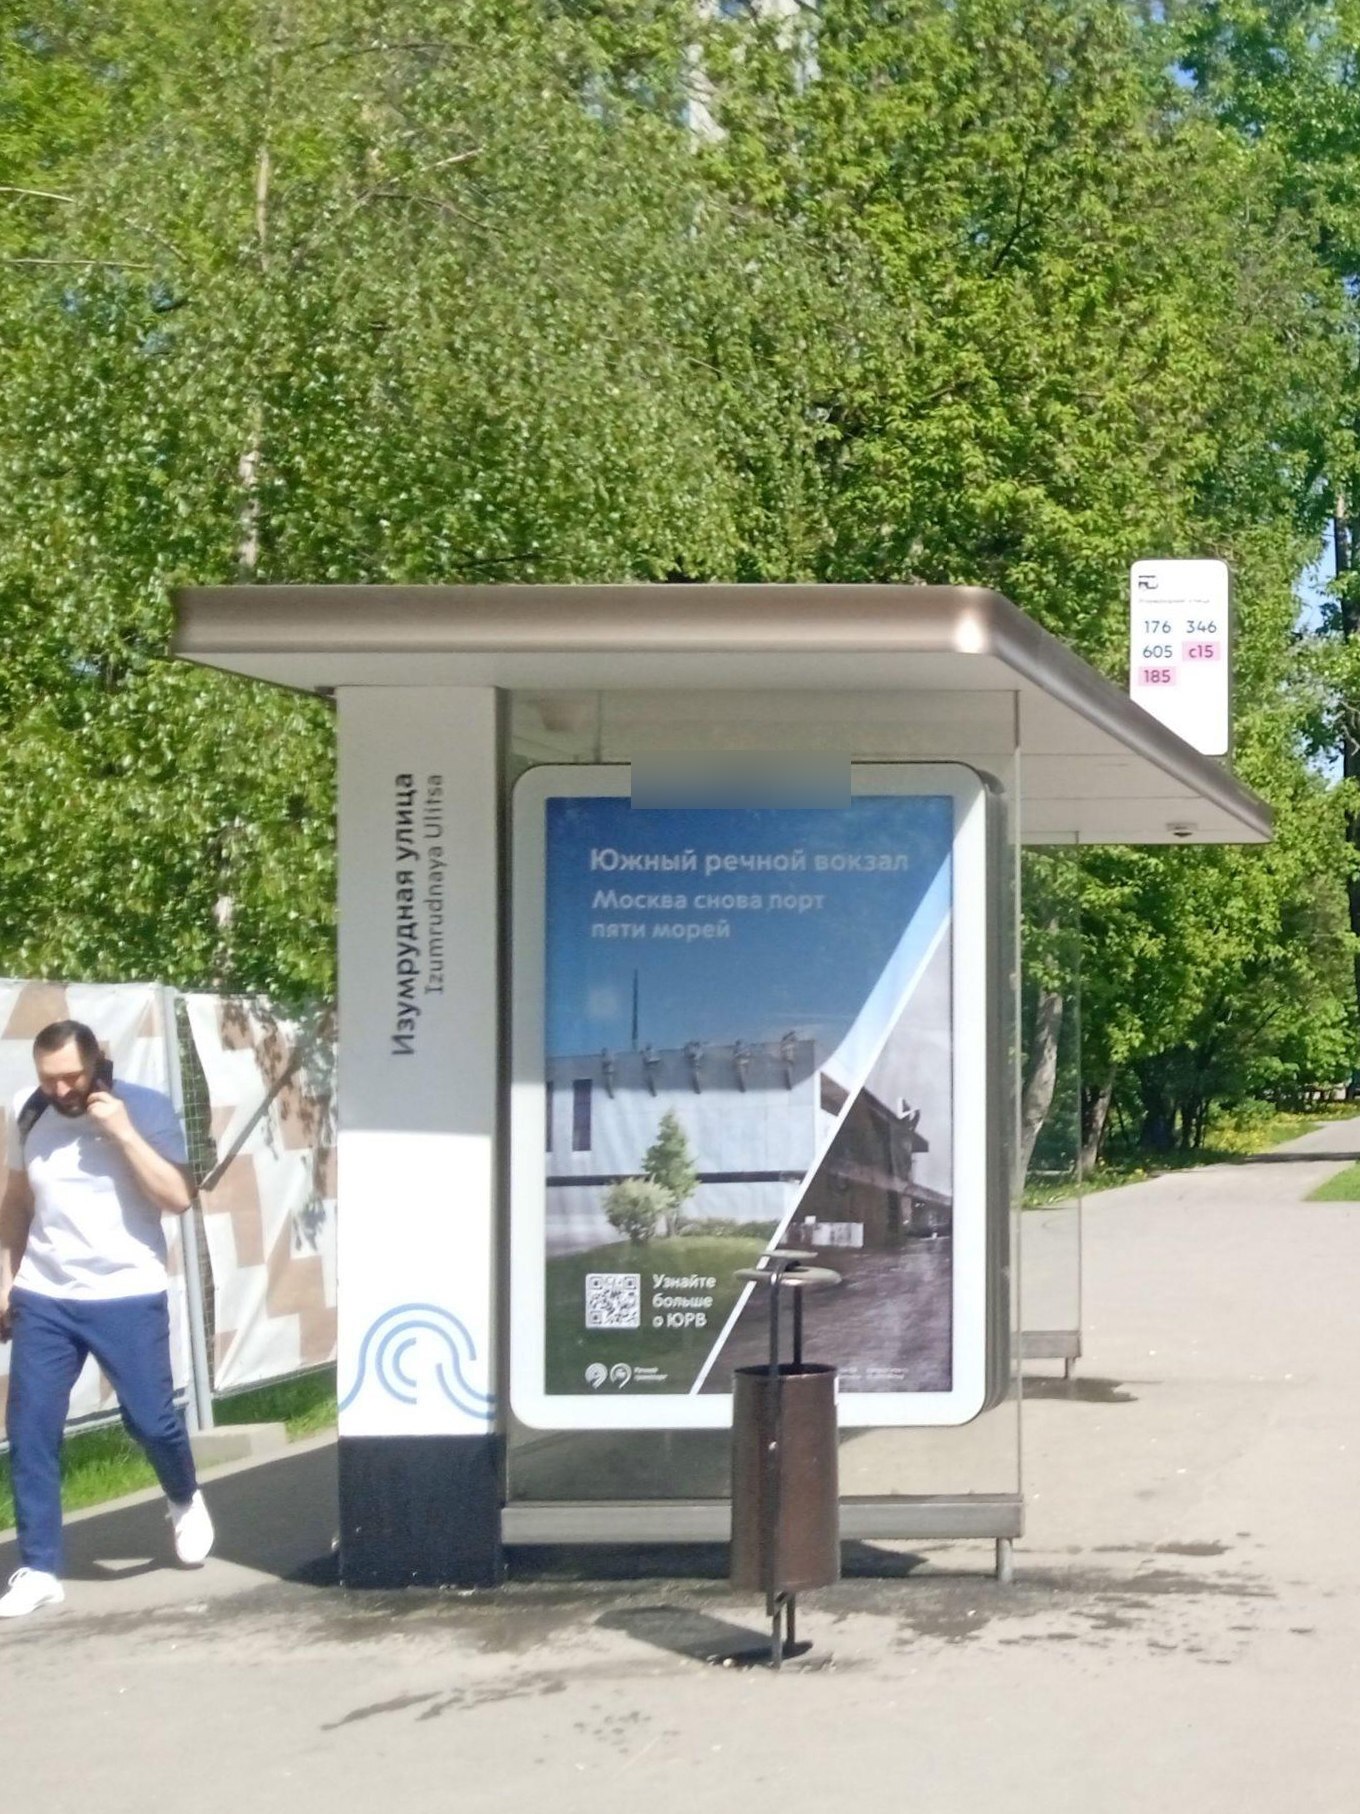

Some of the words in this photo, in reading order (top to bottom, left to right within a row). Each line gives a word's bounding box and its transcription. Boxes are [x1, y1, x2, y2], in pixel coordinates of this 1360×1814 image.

[1144, 620, 1172, 634] 176
[1186, 620, 1217, 634] 346
[1142, 645, 1173, 659] 605
[1143, 669, 1171, 684] 185
[395, 773, 420, 862] улица
[423, 774, 444, 841] Ulitsa
[590, 848, 697, 871] Южный
[705, 849, 806, 876] речной
[815, 854, 909, 871] вокзал
[592, 889, 687, 909] Москва
[694, 894, 763, 909] снова
[768, 894, 825, 914] порт
[424, 846, 447, 995] Izumrudnaya
[591, 923, 646, 938] пяти
[652, 919, 730, 943] морей
[391, 869, 421, 1055] Изумрудная
[652, 1273, 717, 1289] Узнайте
[652, 1292, 713, 1308] больше
[652, 1315, 664, 1328] о
[666, 1312, 707, 1328] ЮРВ
